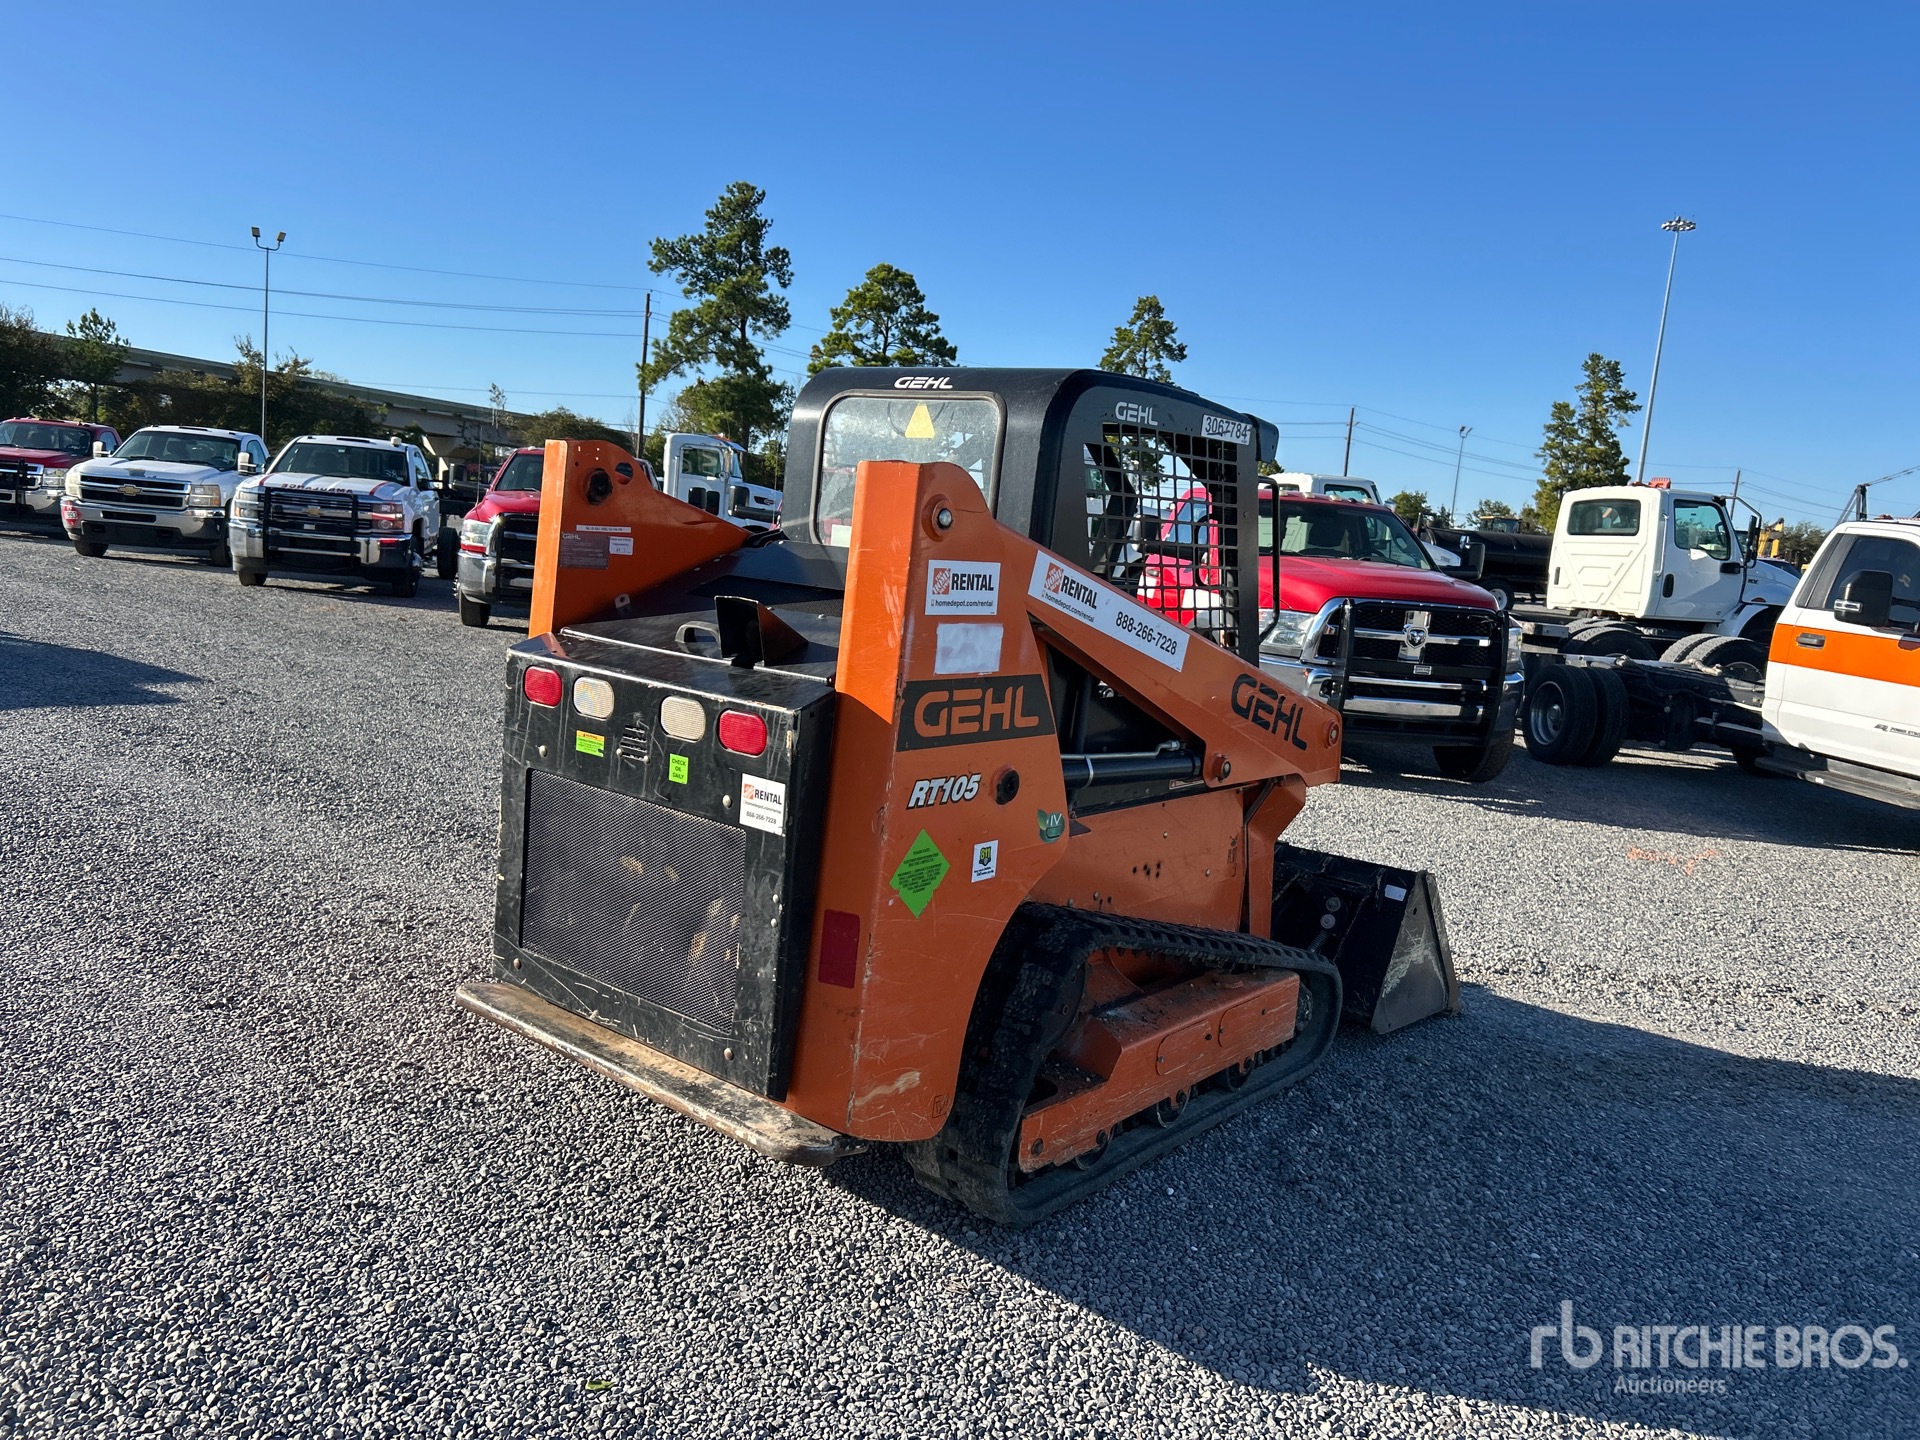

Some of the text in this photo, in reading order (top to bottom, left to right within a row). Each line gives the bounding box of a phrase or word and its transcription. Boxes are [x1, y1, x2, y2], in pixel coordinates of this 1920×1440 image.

[894, 376, 953, 389] GEHL
[1115, 401, 1158, 426] GEHL
[951, 573, 994, 591] RENTAL
[935, 600, 993, 608] homedepot.com/rental
[1045, 592, 1094, 622] homedepot.com/rental
[1060, 575, 1177, 655] RENTAL 888-266-7228
[914, 685, 1039, 737] GEHL
[1231, 673, 1307, 751] GEHL
[754, 788, 782, 805] RENTAL
[906, 772, 981, 810] RT105
[980, 846, 991, 859] 811
